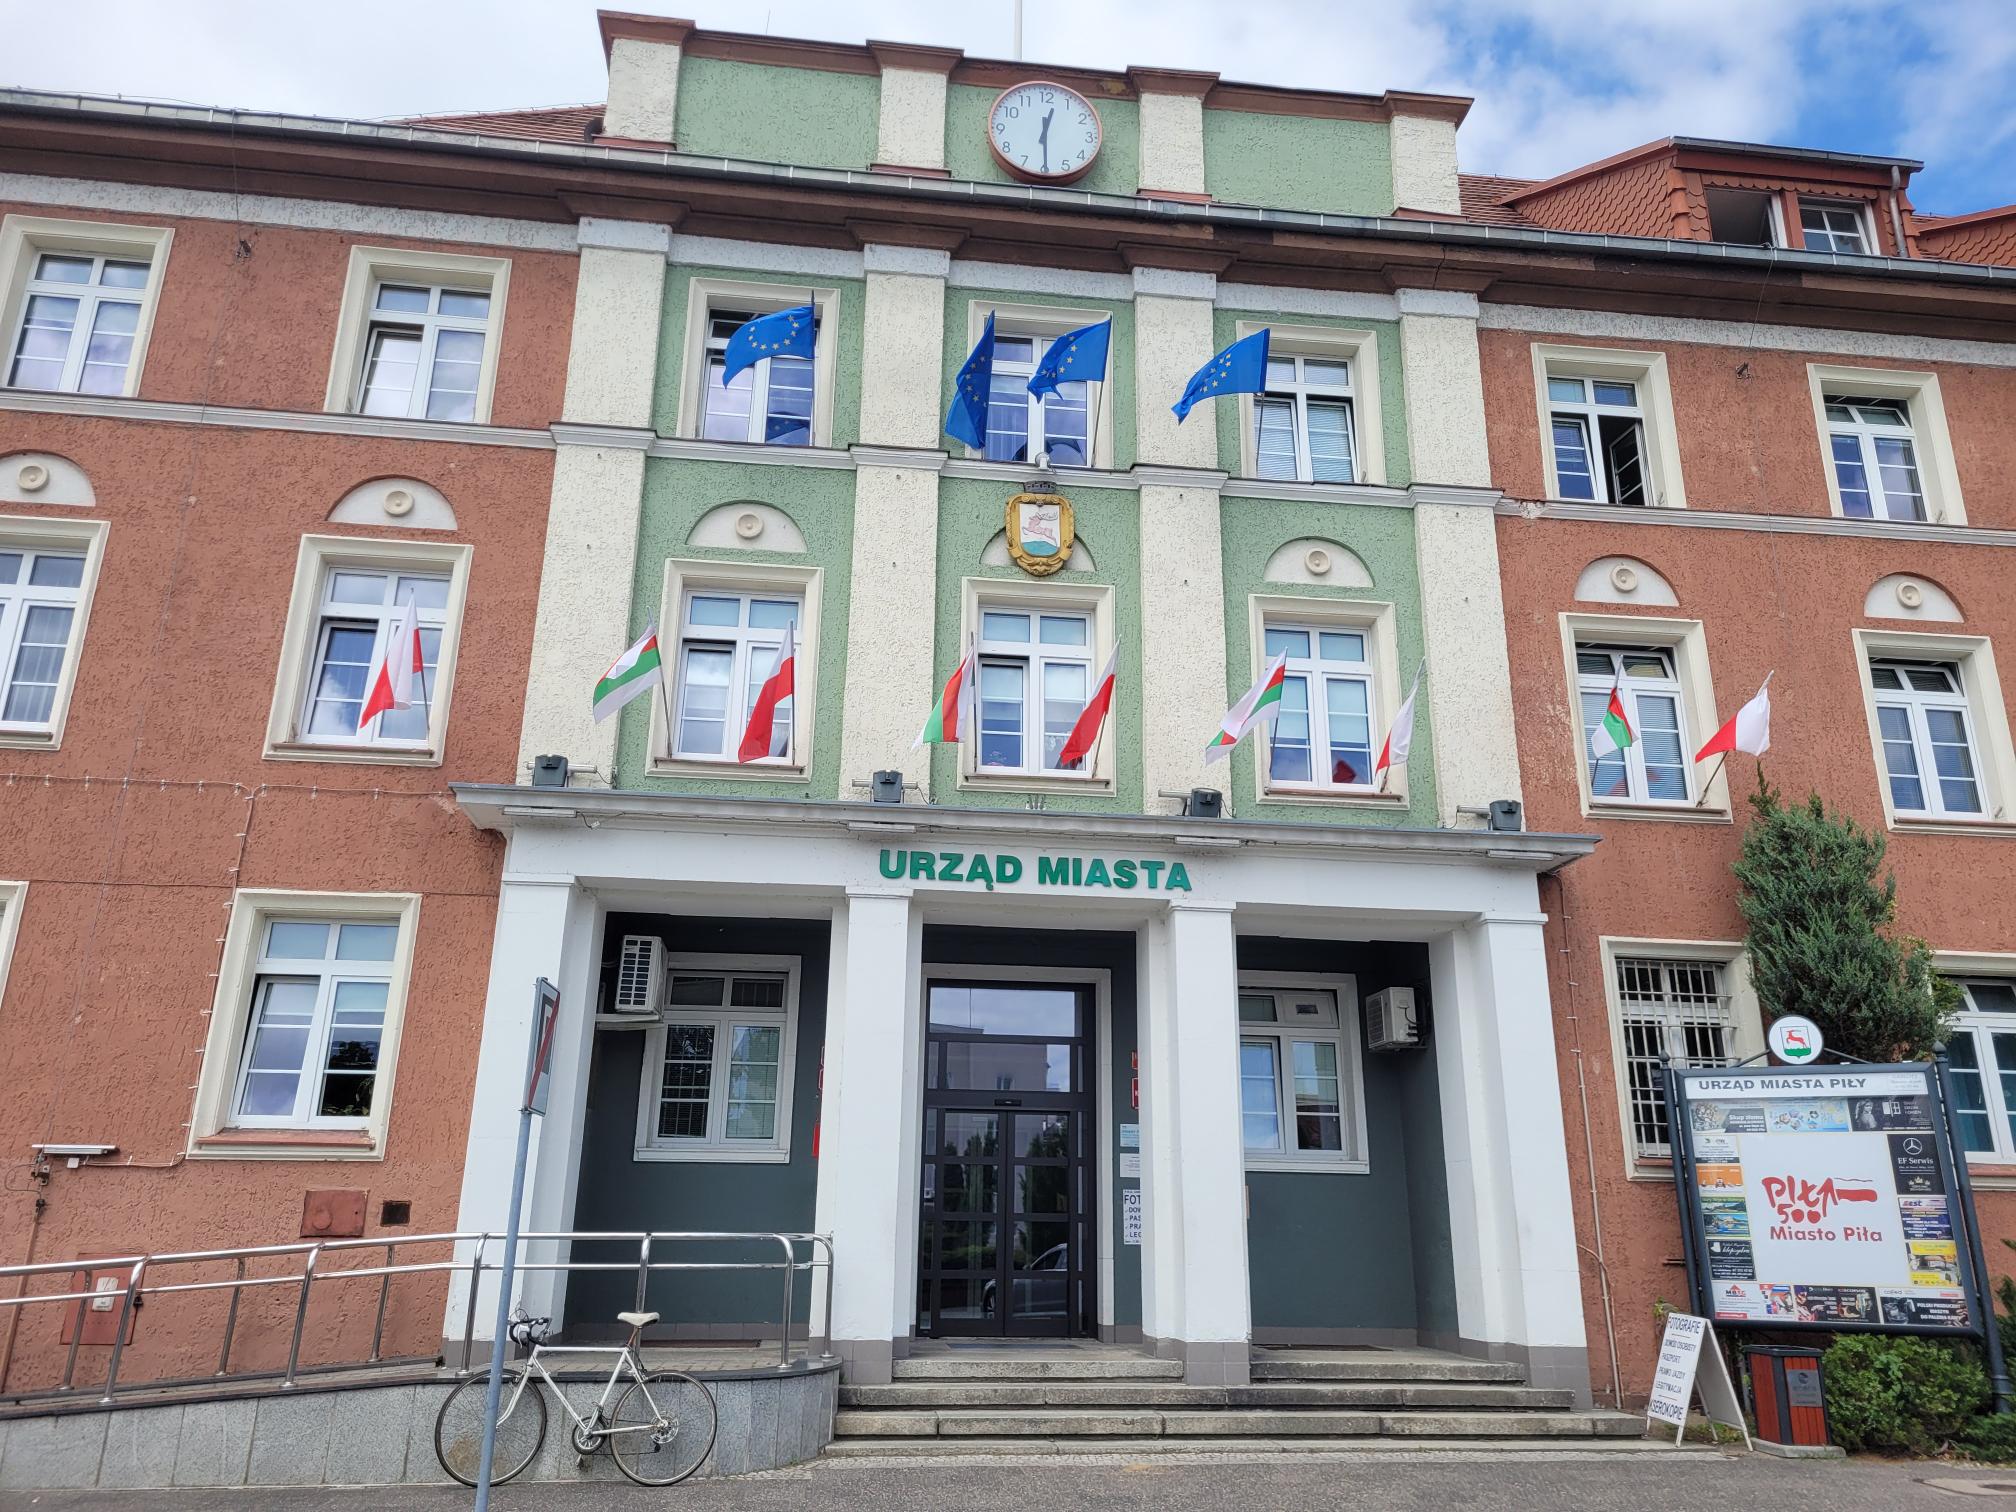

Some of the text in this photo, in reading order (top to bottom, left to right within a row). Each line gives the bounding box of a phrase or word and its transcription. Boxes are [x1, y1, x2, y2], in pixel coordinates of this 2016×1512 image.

[1019, 94, 1031, 108] 11
[1039, 91, 1055, 104] 12
[1064, 98, 1070, 110] 1
[1004, 105, 1019, 119] 10
[1078, 112, 1087, 125] 2
[996, 122, 1006, 135] 9
[1085, 131, 1094, 144] 3
[1002, 141, 1011, 153] 8
[1020, 155, 1029, 167] 7
[1076, 149, 1086, 161] 4
[1061, 160, 1071, 172] 5
[879, 848, 1192, 892] URZĄD MIASTA
[1698, 1077, 1867, 1092] URZĄD MIASTA PIŁY
[1908, 1157, 1934, 1165] Serwis
[1769, 1225, 1837, 1241] Miasto
[1843, 1225, 1884, 1241] Piła
